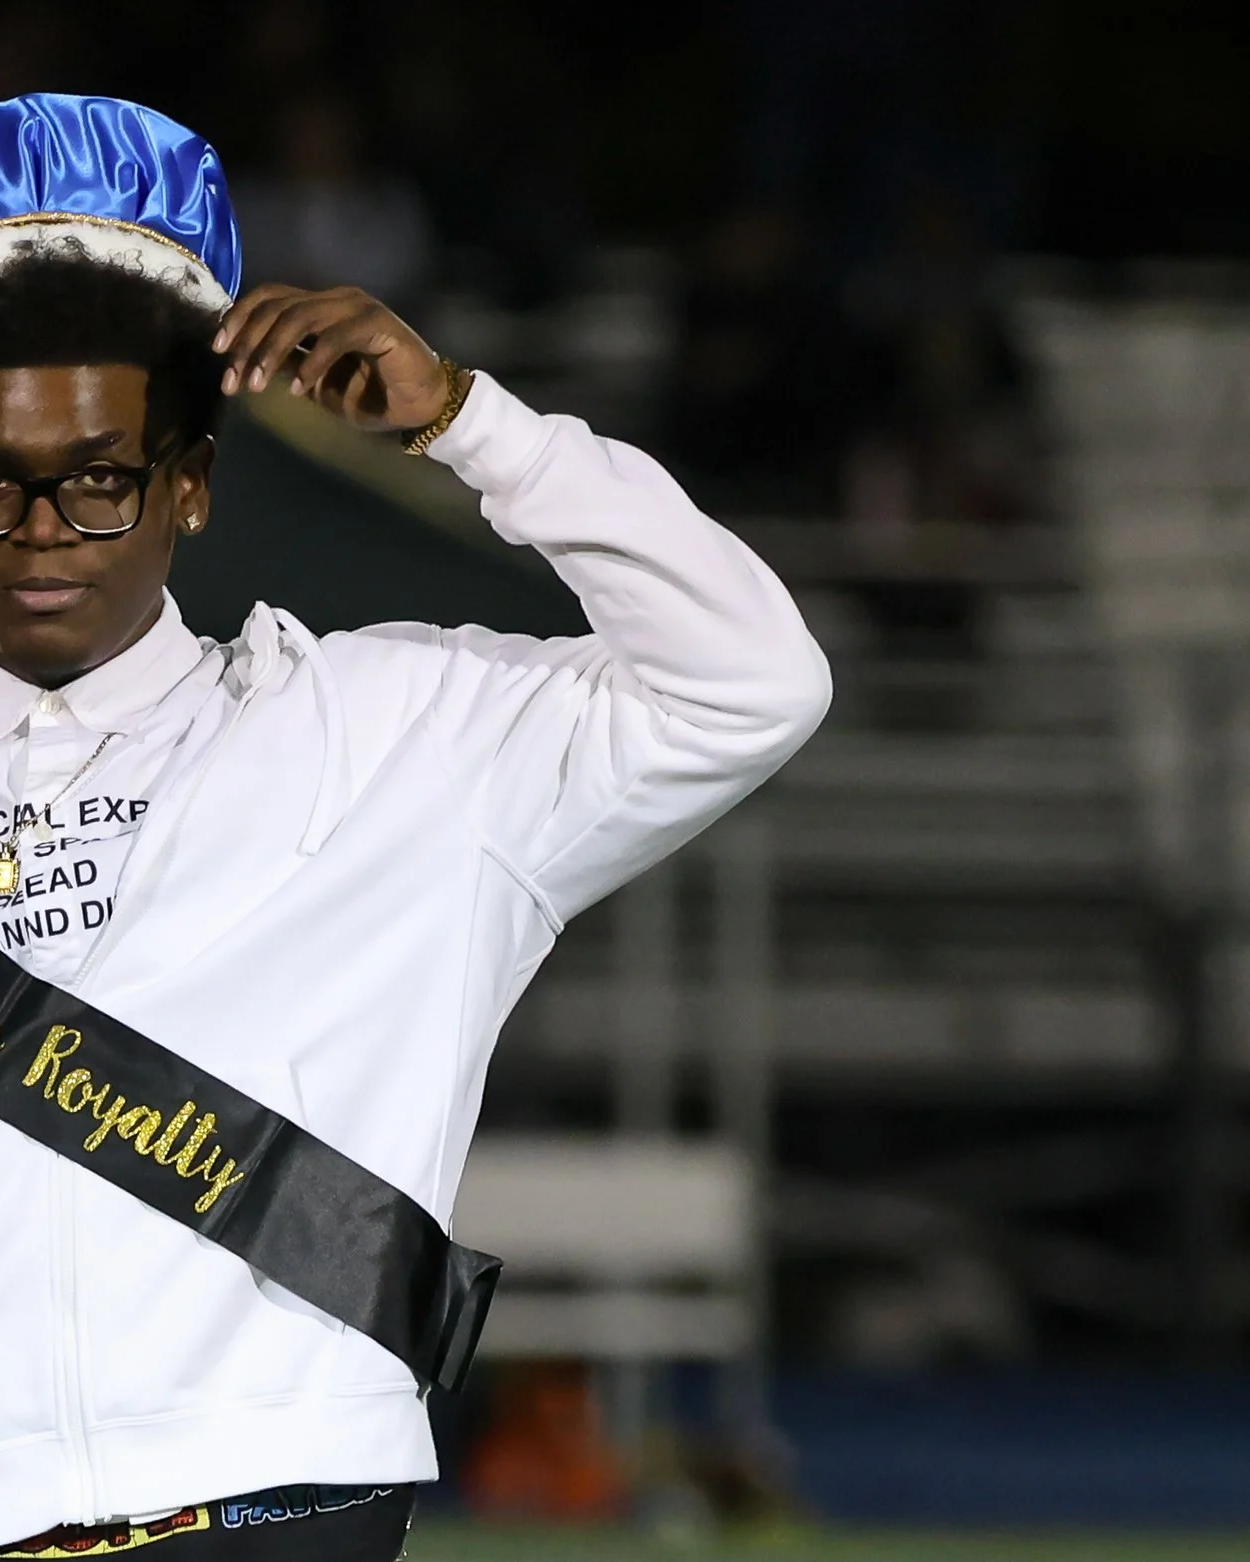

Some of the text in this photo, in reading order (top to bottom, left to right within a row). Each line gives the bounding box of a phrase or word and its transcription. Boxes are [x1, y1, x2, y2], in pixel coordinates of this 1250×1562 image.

[79, 796, 150, 826] EXP
[33, 836, 102, 858] SP
[21, 1024, 245, 1213] Royalty
